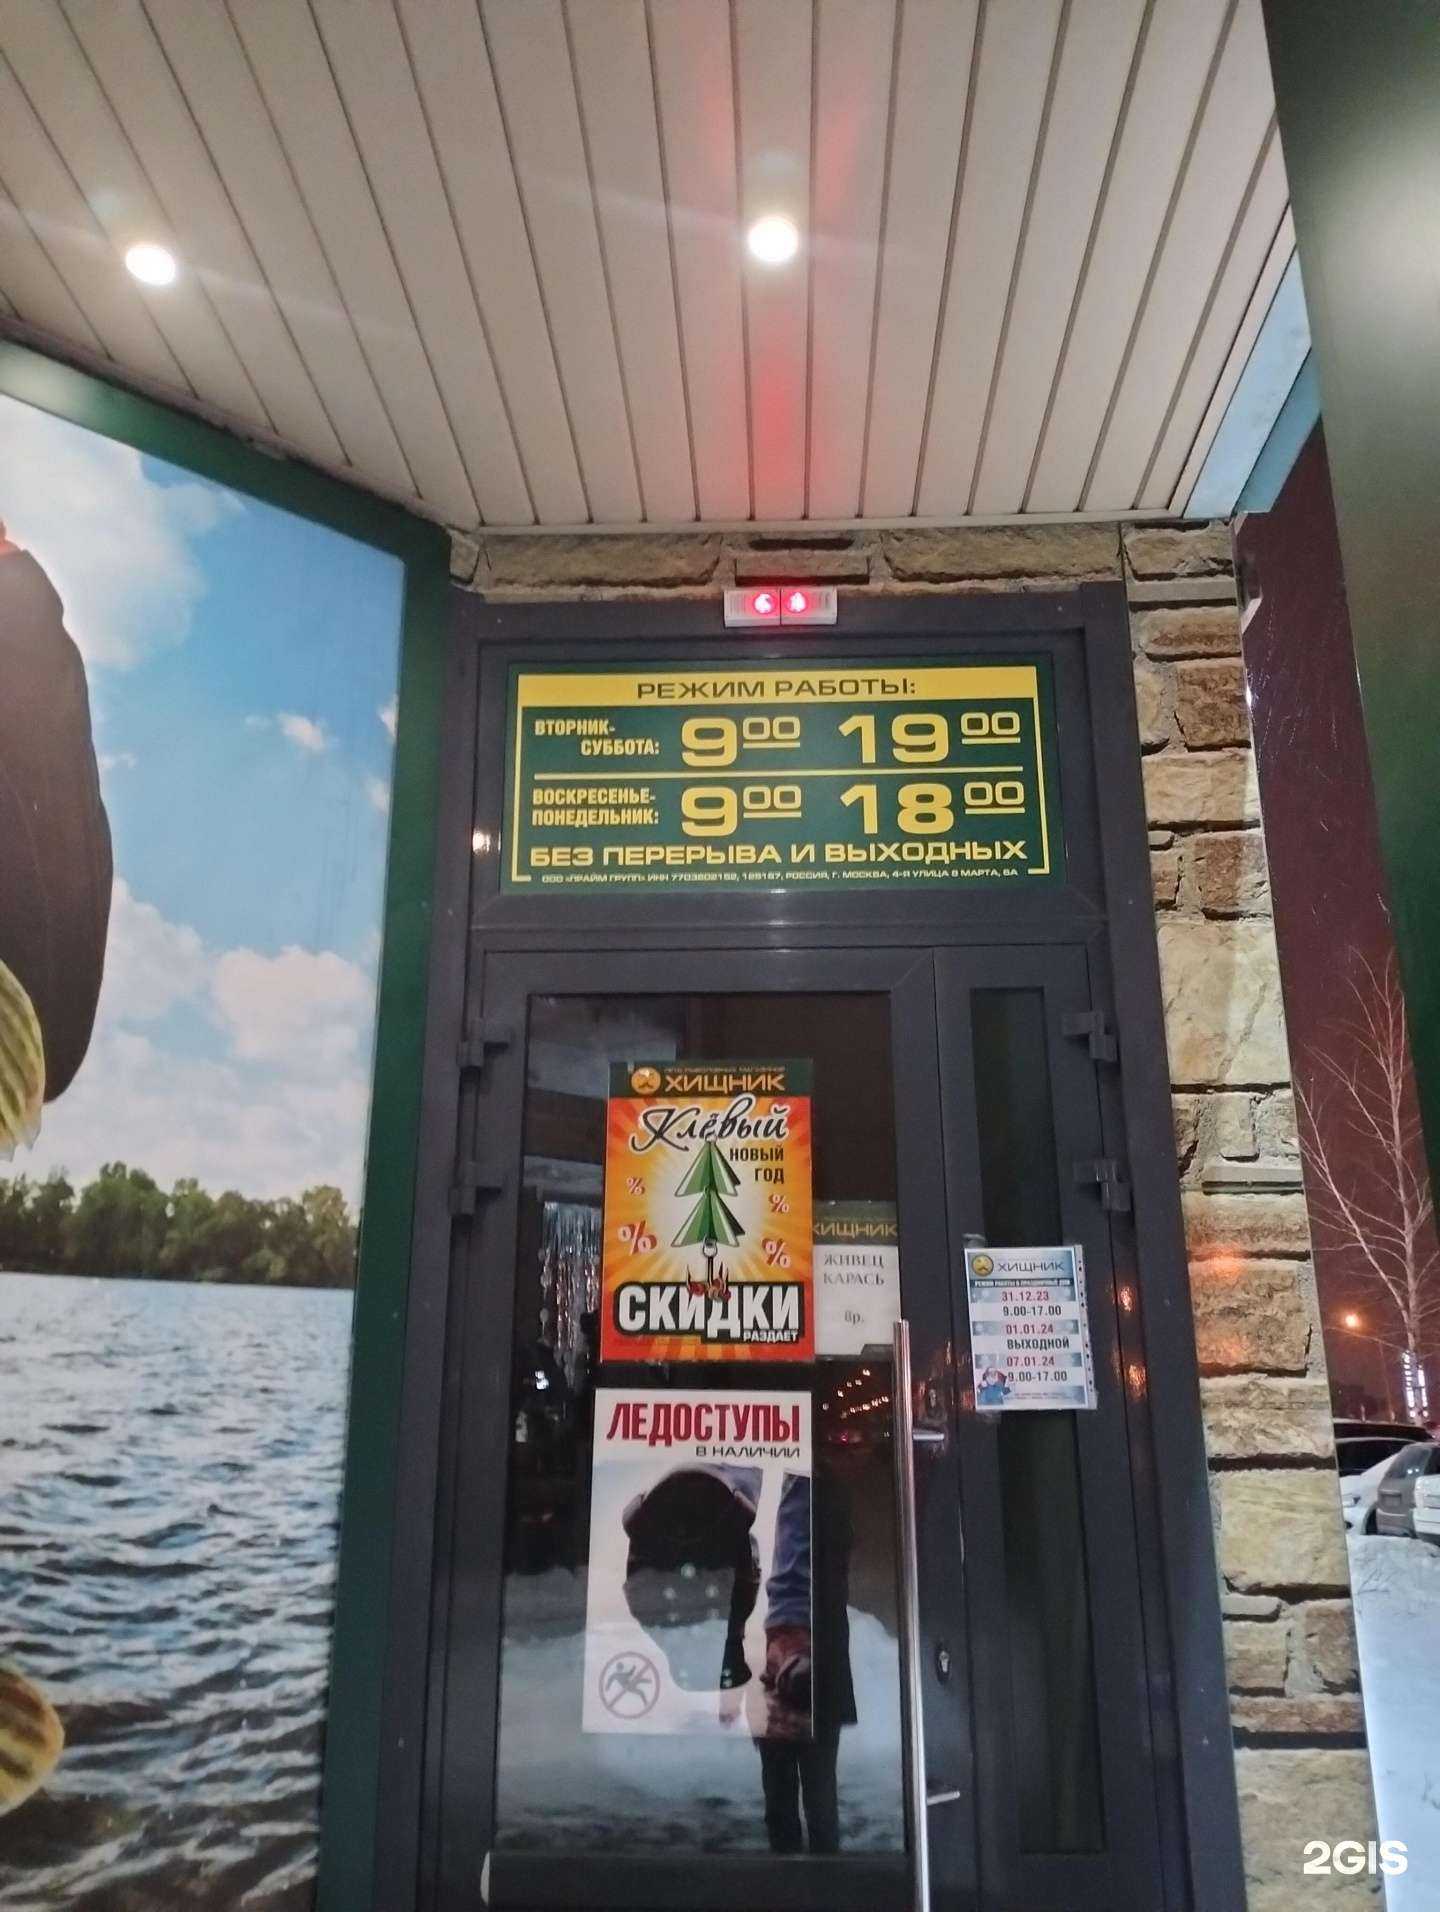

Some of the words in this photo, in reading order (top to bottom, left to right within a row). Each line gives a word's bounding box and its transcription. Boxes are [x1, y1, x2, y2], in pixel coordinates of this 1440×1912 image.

[637, 681, 765, 699] РЕЖИМ
[774, 678, 916, 697] РАБОТЫ:
[535, 718, 616, 736] ВТОРНИК-
[580, 738, 660, 756] СУББОТА:
[532, 787, 656, 805] ВОСКРЕСЕНЬЕ-
[532, 808, 659, 828] ПОНЕДЕЛЬНИК:
[530, 847, 593, 867] БЕЗ
[602, 844, 782, 866] ПЕРЕРЫВА
[791, 844, 815, 863] И
[825, 840, 1028, 865] ВЫХОДНЫХ
[842, 870, 890, 879] МОСКВА,
[960, 868, 1001, 877] МАРТА,
[665, 1074, 785, 1094] ХИЩНИК
[631, 1096, 788, 1152] Клёвый
[729, 1145, 784, 1162] НОВЫЙ
[754, 1167, 785, 1184] ГОД
[998, 1261, 1065, 1272] ХИЩНИК
[823, 1272, 884, 1285] КАРАСЬ
[1002, 1291, 1049, 1301] 31.12.23
[618, 1284, 800, 1338] СКИДКИ
[1003, 1305, 1062, 1317] 9.00-17.00
[743, 1329, 799, 1343] РАЗДАЕТ
[1006, 1324, 1054, 1334] 01.01.24
[1007, 1337, 1070, 1351] ВЫХОДНОЙ
[1007, 1357, 1055, 1367] 07.01.24
[1008, 1371, 1068, 1382] 9.00-17.00
[607, 1403, 800, 1446] ЛЕДОСТУПЫ
[696, 1446, 706, 1457] В
[712, 1446, 800, 1458] НАЛИЧИИ
